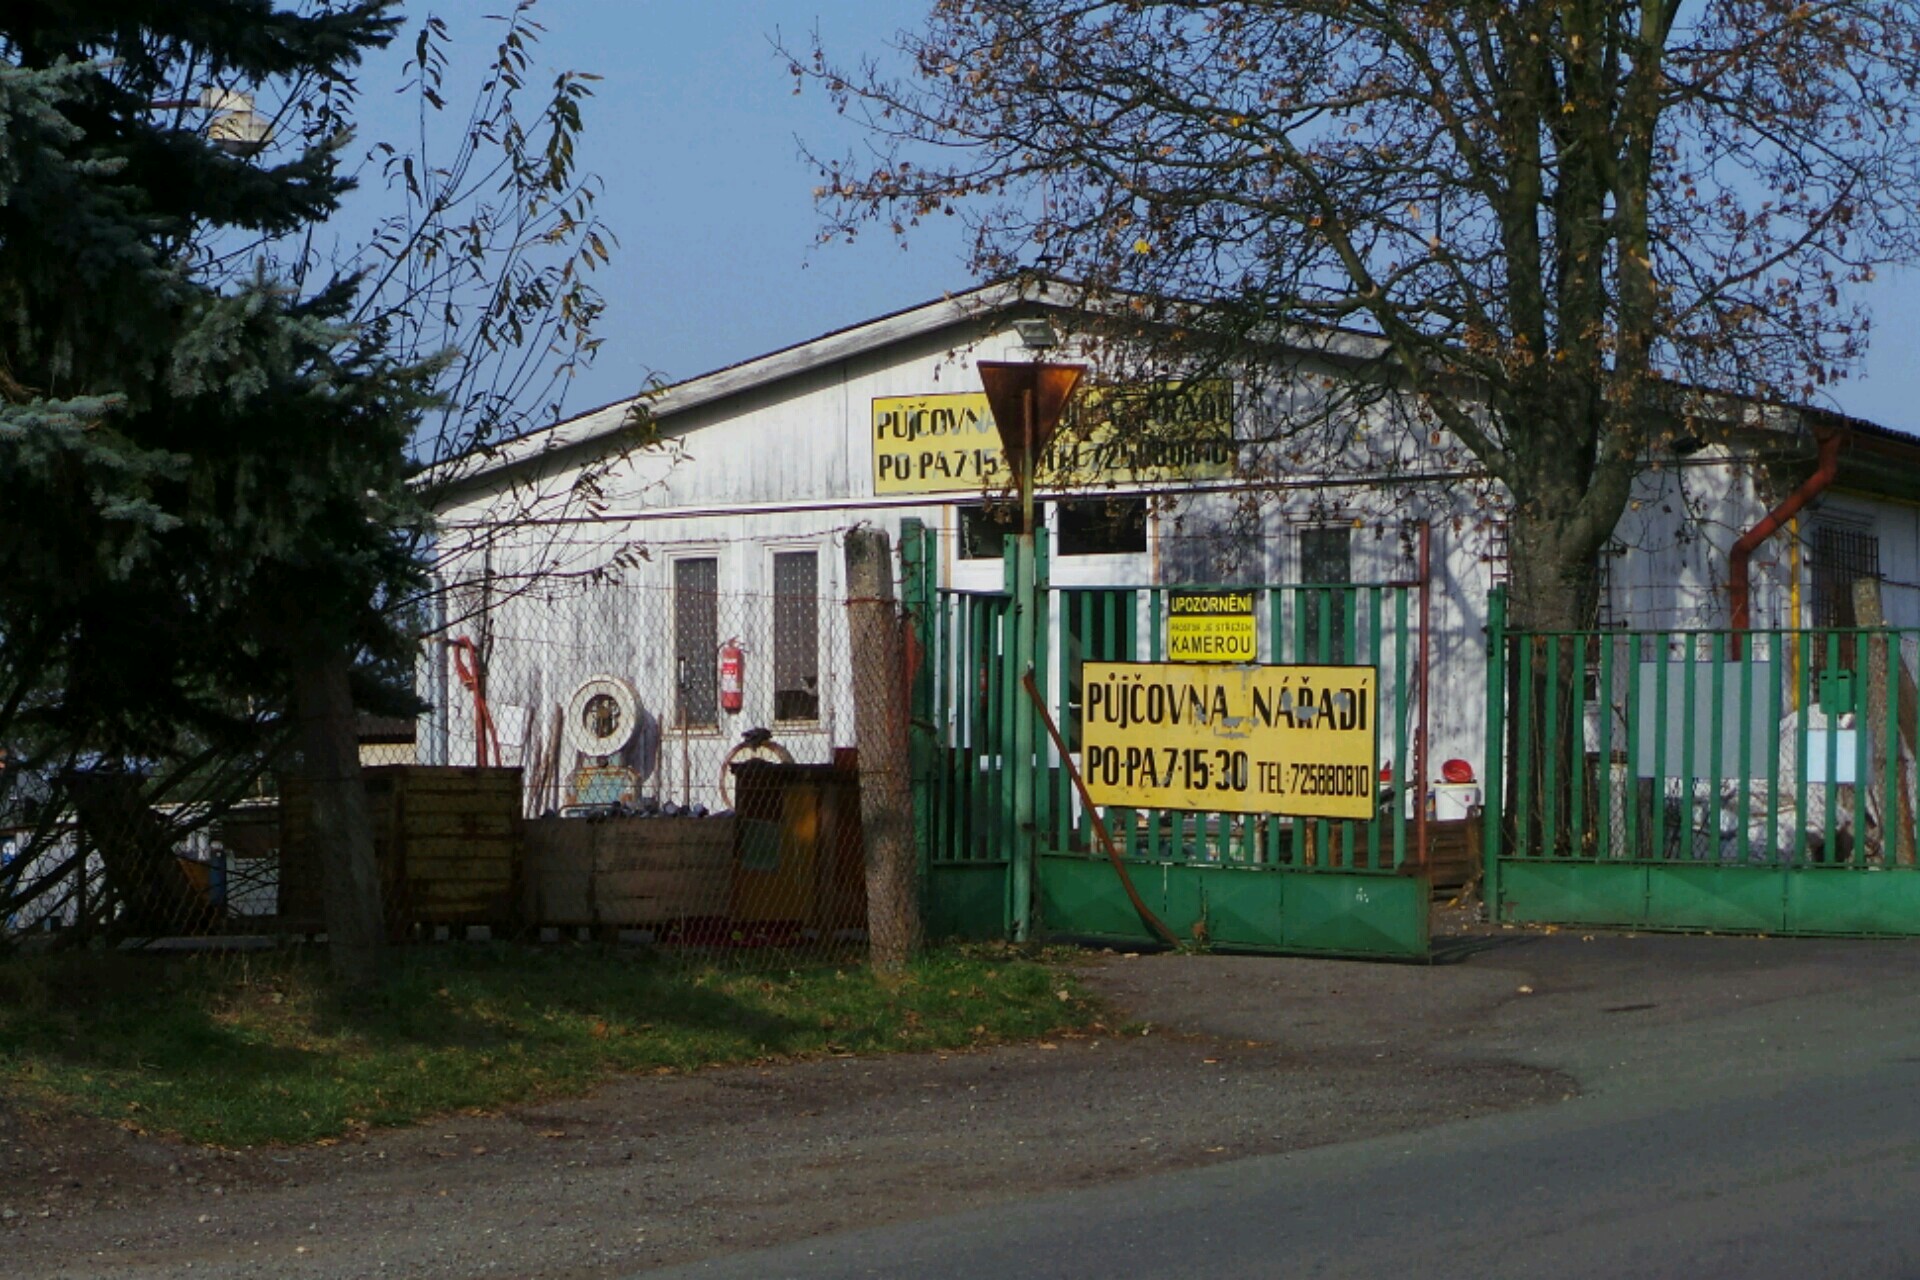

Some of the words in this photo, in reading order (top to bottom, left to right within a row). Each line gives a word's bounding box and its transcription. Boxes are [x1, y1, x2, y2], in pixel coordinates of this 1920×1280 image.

[1171, 593, 1253, 612] UPOZORNĚNÍ
[1171, 635, 1251, 653] KAMEROU
[1252, 676, 1368, 731] NÁŘADÍ
